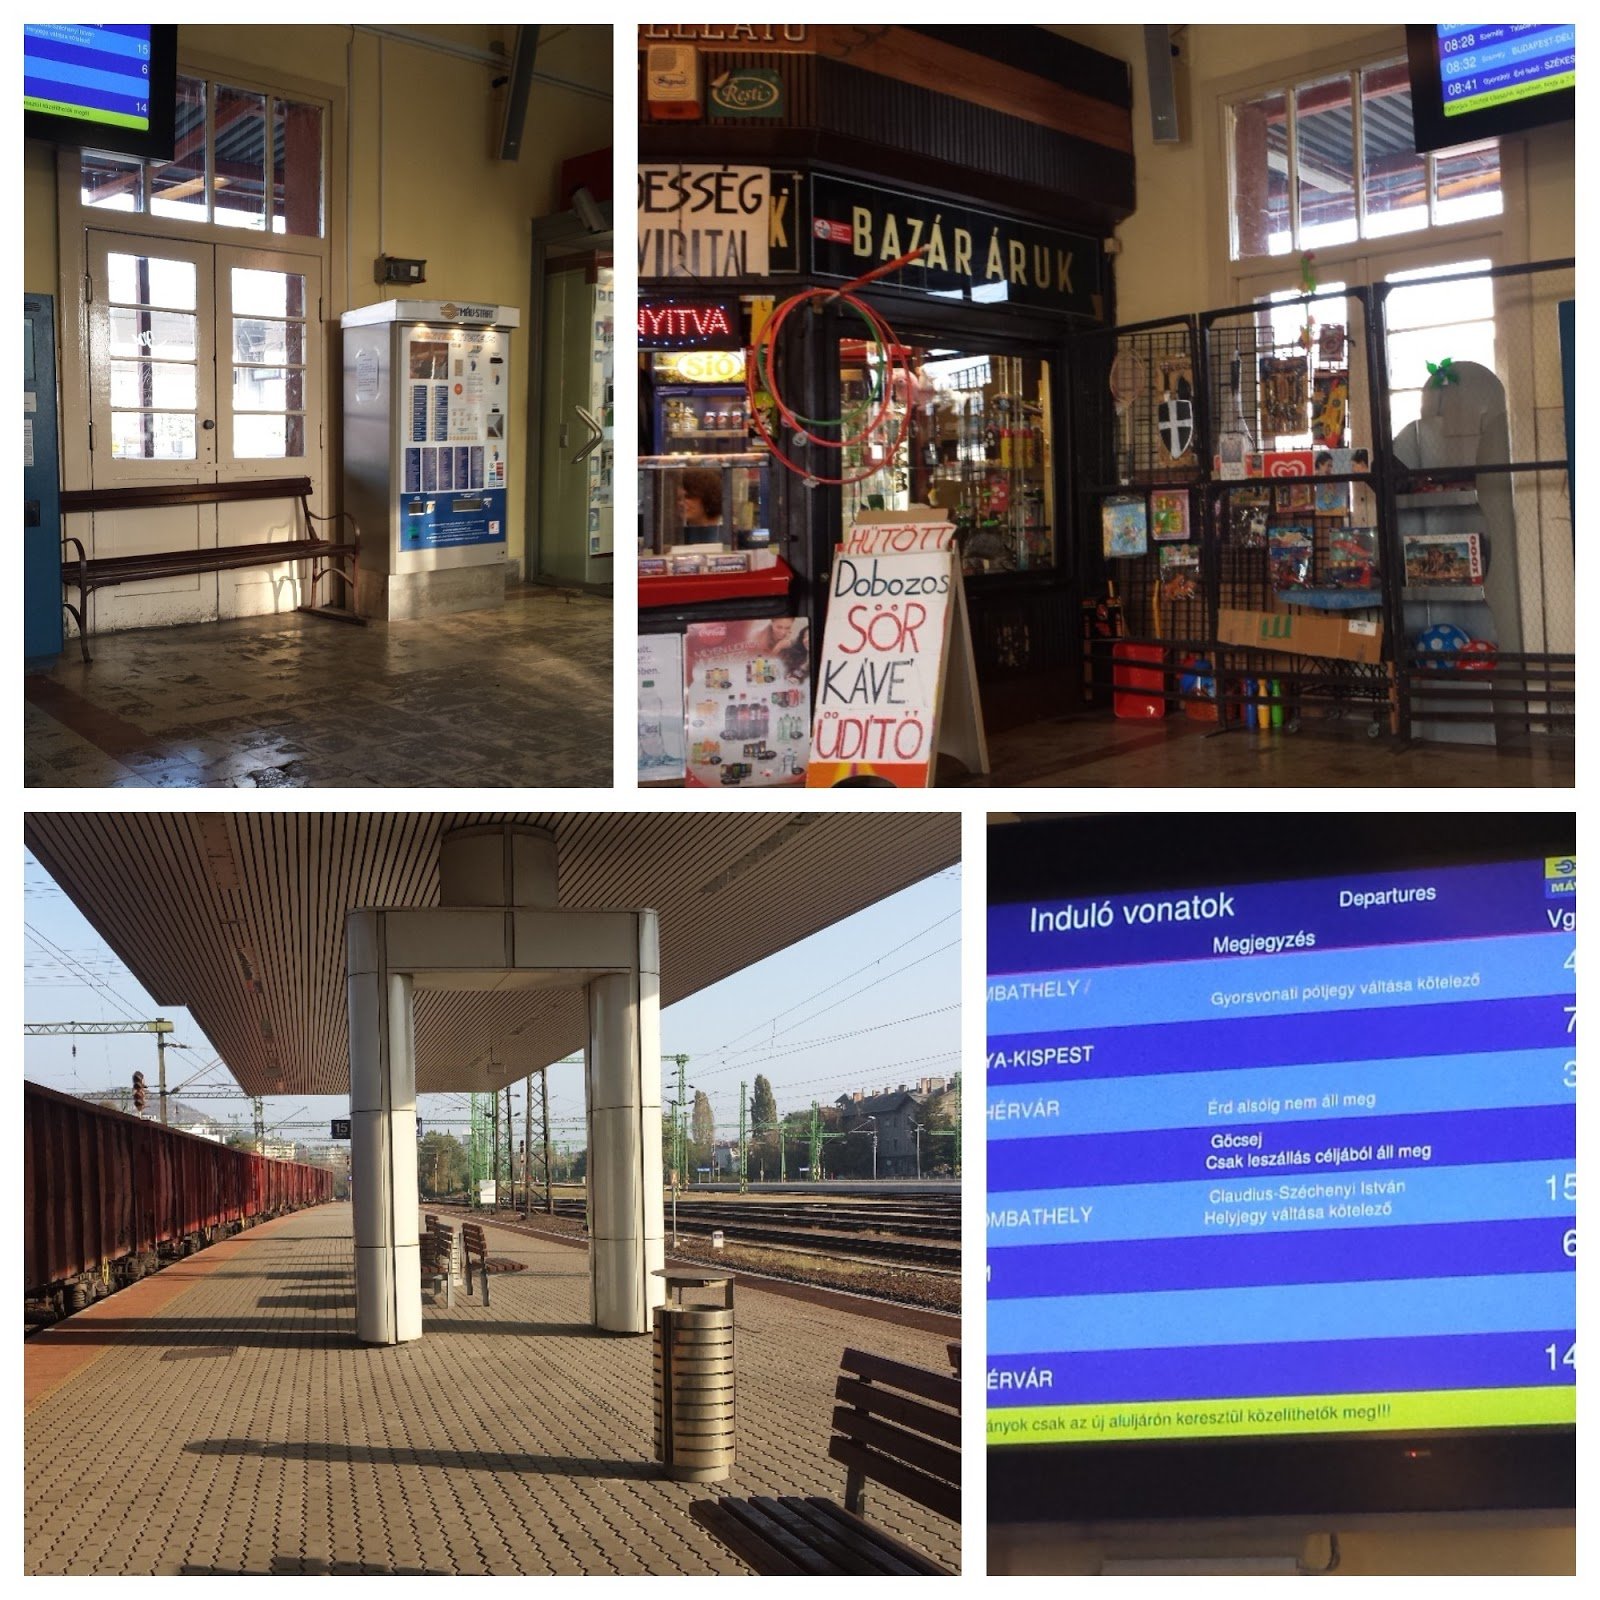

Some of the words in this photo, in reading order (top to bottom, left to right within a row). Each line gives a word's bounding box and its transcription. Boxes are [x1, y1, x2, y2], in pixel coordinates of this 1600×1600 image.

[137, 44, 149, 55] 15
[1444, 34, 1475, 53] 08:28
[141, 64, 148, 75] 6
[1446, 56, 1477, 75] 08:32
[1447, 79, 1478, 97] 08:41
[136, 102, 148, 113] 14
[853, 206, 972, 277] BAZÁR
[986, 226, 1074, 295] ÁRUK
[847, 524, 954, 555] HÜTÖTT
[835, 558, 950, 597] Dobozos
[838, 602, 927, 654] SÖR
[821, 657, 915, 705] KÁVÉ
[1339, 886, 1437, 909] Departures
[1030, 900, 1114, 933] Induló
[1123, 890, 1236, 925] vonatok
[1212, 929, 1316, 955] Megjegyzés
[1210, 986, 1298, 1009] Gyorsvonati
[1302, 984, 1356, 1003] pótjegy
[1360, 977, 1413, 995] váltása
[1563, 1006, 1576, 1033] 7
[1207, 1098, 1234, 1116] Érd
[1237, 1097, 1281, 1115] alsóig
[1285, 1096, 1318, 1110] nem
[1322, 1093, 1340, 1109] áll
[1343, 1093, 1377, 1110] meg
[335, 1122, 349, 1133] 15
[1205, 1153, 1245, 1170] Csak
[1248, 1149, 1312, 1168] leszállás
[1315, 1145, 1373, 1166] céljából
[1376, 1143, 1395, 1160] áll
[1398, 1145, 1432, 1161] meg
[1209, 1182, 1357, 1205] Claudius-Széchenyi
[1360, 1179, 1406, 1197] István
[1545, 1173, 1576, 1201] 15
[1204, 1208, 1267, 1228] Helyjegy
[1271, 1205, 1325, 1222] váltása
[1329, 1199, 1393, 1219] kötelező
[1562, 1229, 1576, 1257] 6
[1545, 1343, 1576, 1371] 14
[987, 1366, 1053, 1390] ÉRVÁR
[1032, 1416, 1066, 1432] csak
[1070, 1418, 1088, 1430] az
[1091, 1414, 1105, 1433] új
[1109, 1412, 1171, 1431] aluljárón
[1176, 1410, 1243, 1426] keresztül
[1343, 1403, 1391, 1422] meg!!!
